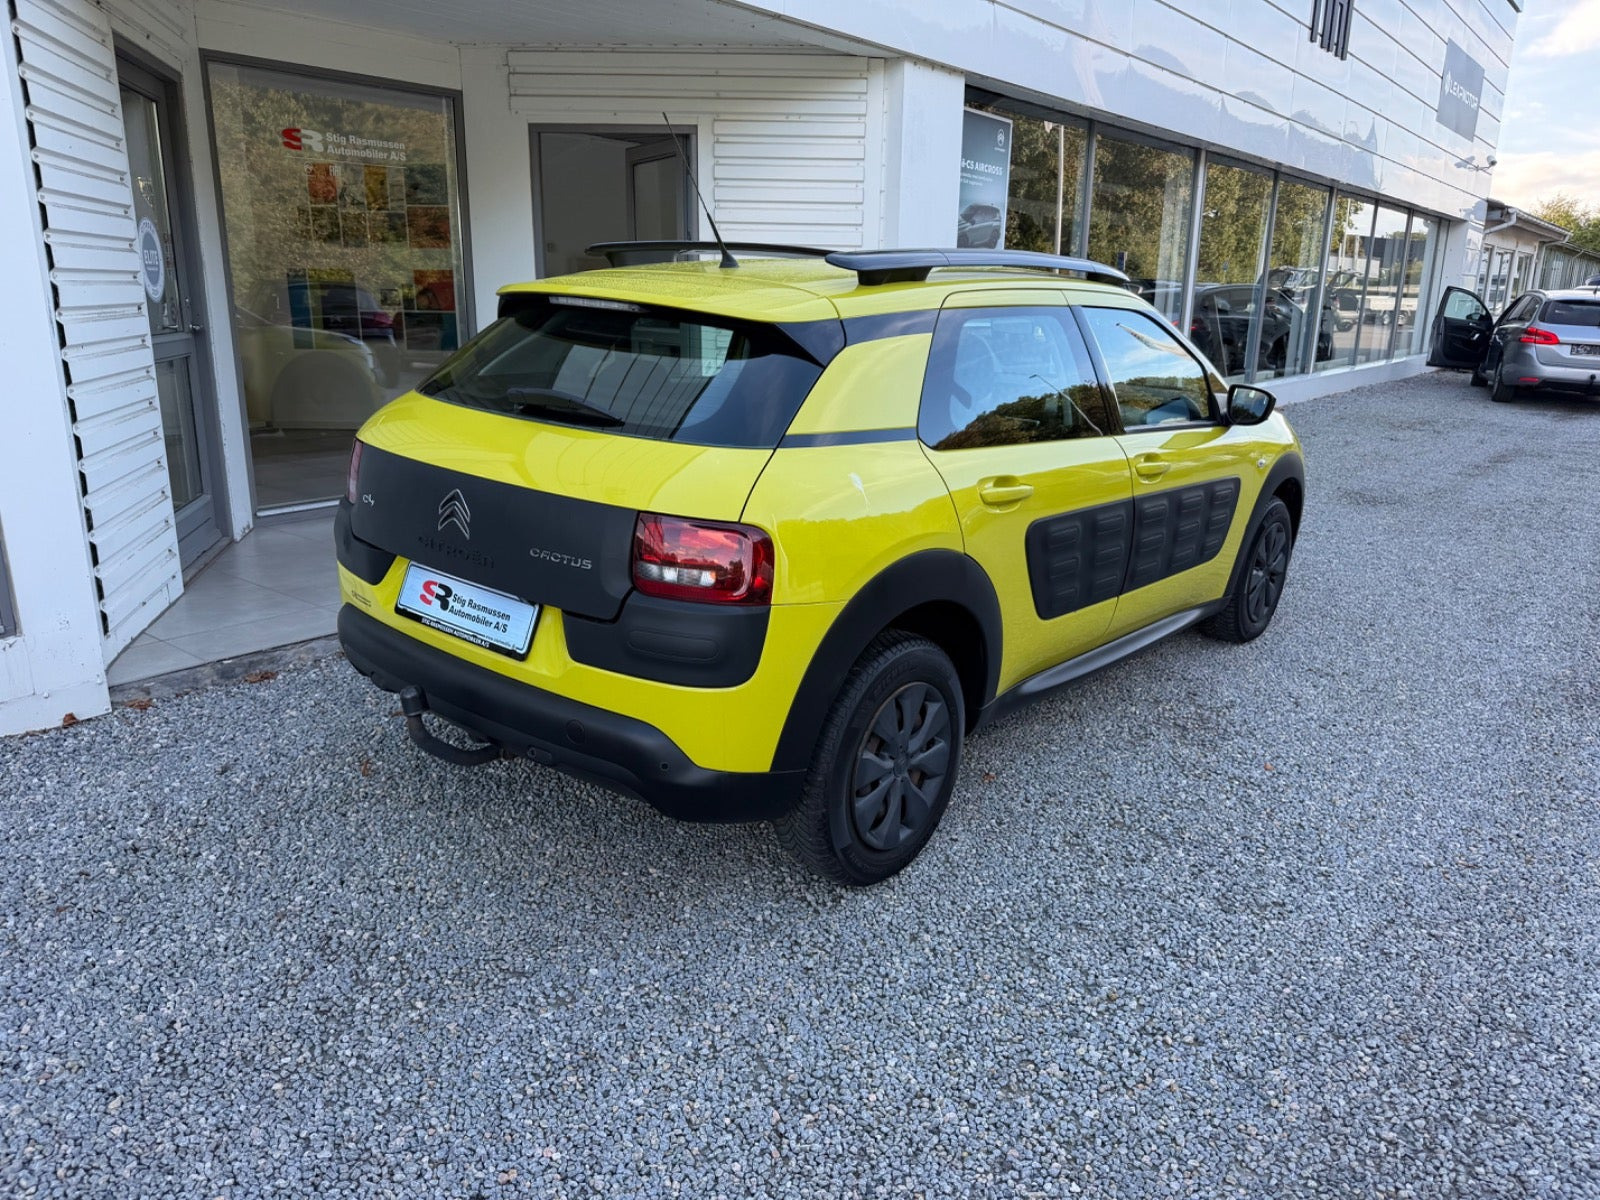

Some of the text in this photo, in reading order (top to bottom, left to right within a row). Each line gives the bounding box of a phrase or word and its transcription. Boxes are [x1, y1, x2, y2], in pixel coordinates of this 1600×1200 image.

[326, 132, 406, 150] Stig Rasmussen
[327, 145, 407, 162] Automobiler A/S
[975, 161, 1003, 176] AIRCROSS
[529, 547, 593, 570] CACTUS
[451, 593, 511, 622] Stig Rasmussen
[448, 605, 509, 634] Automobiler A/S
